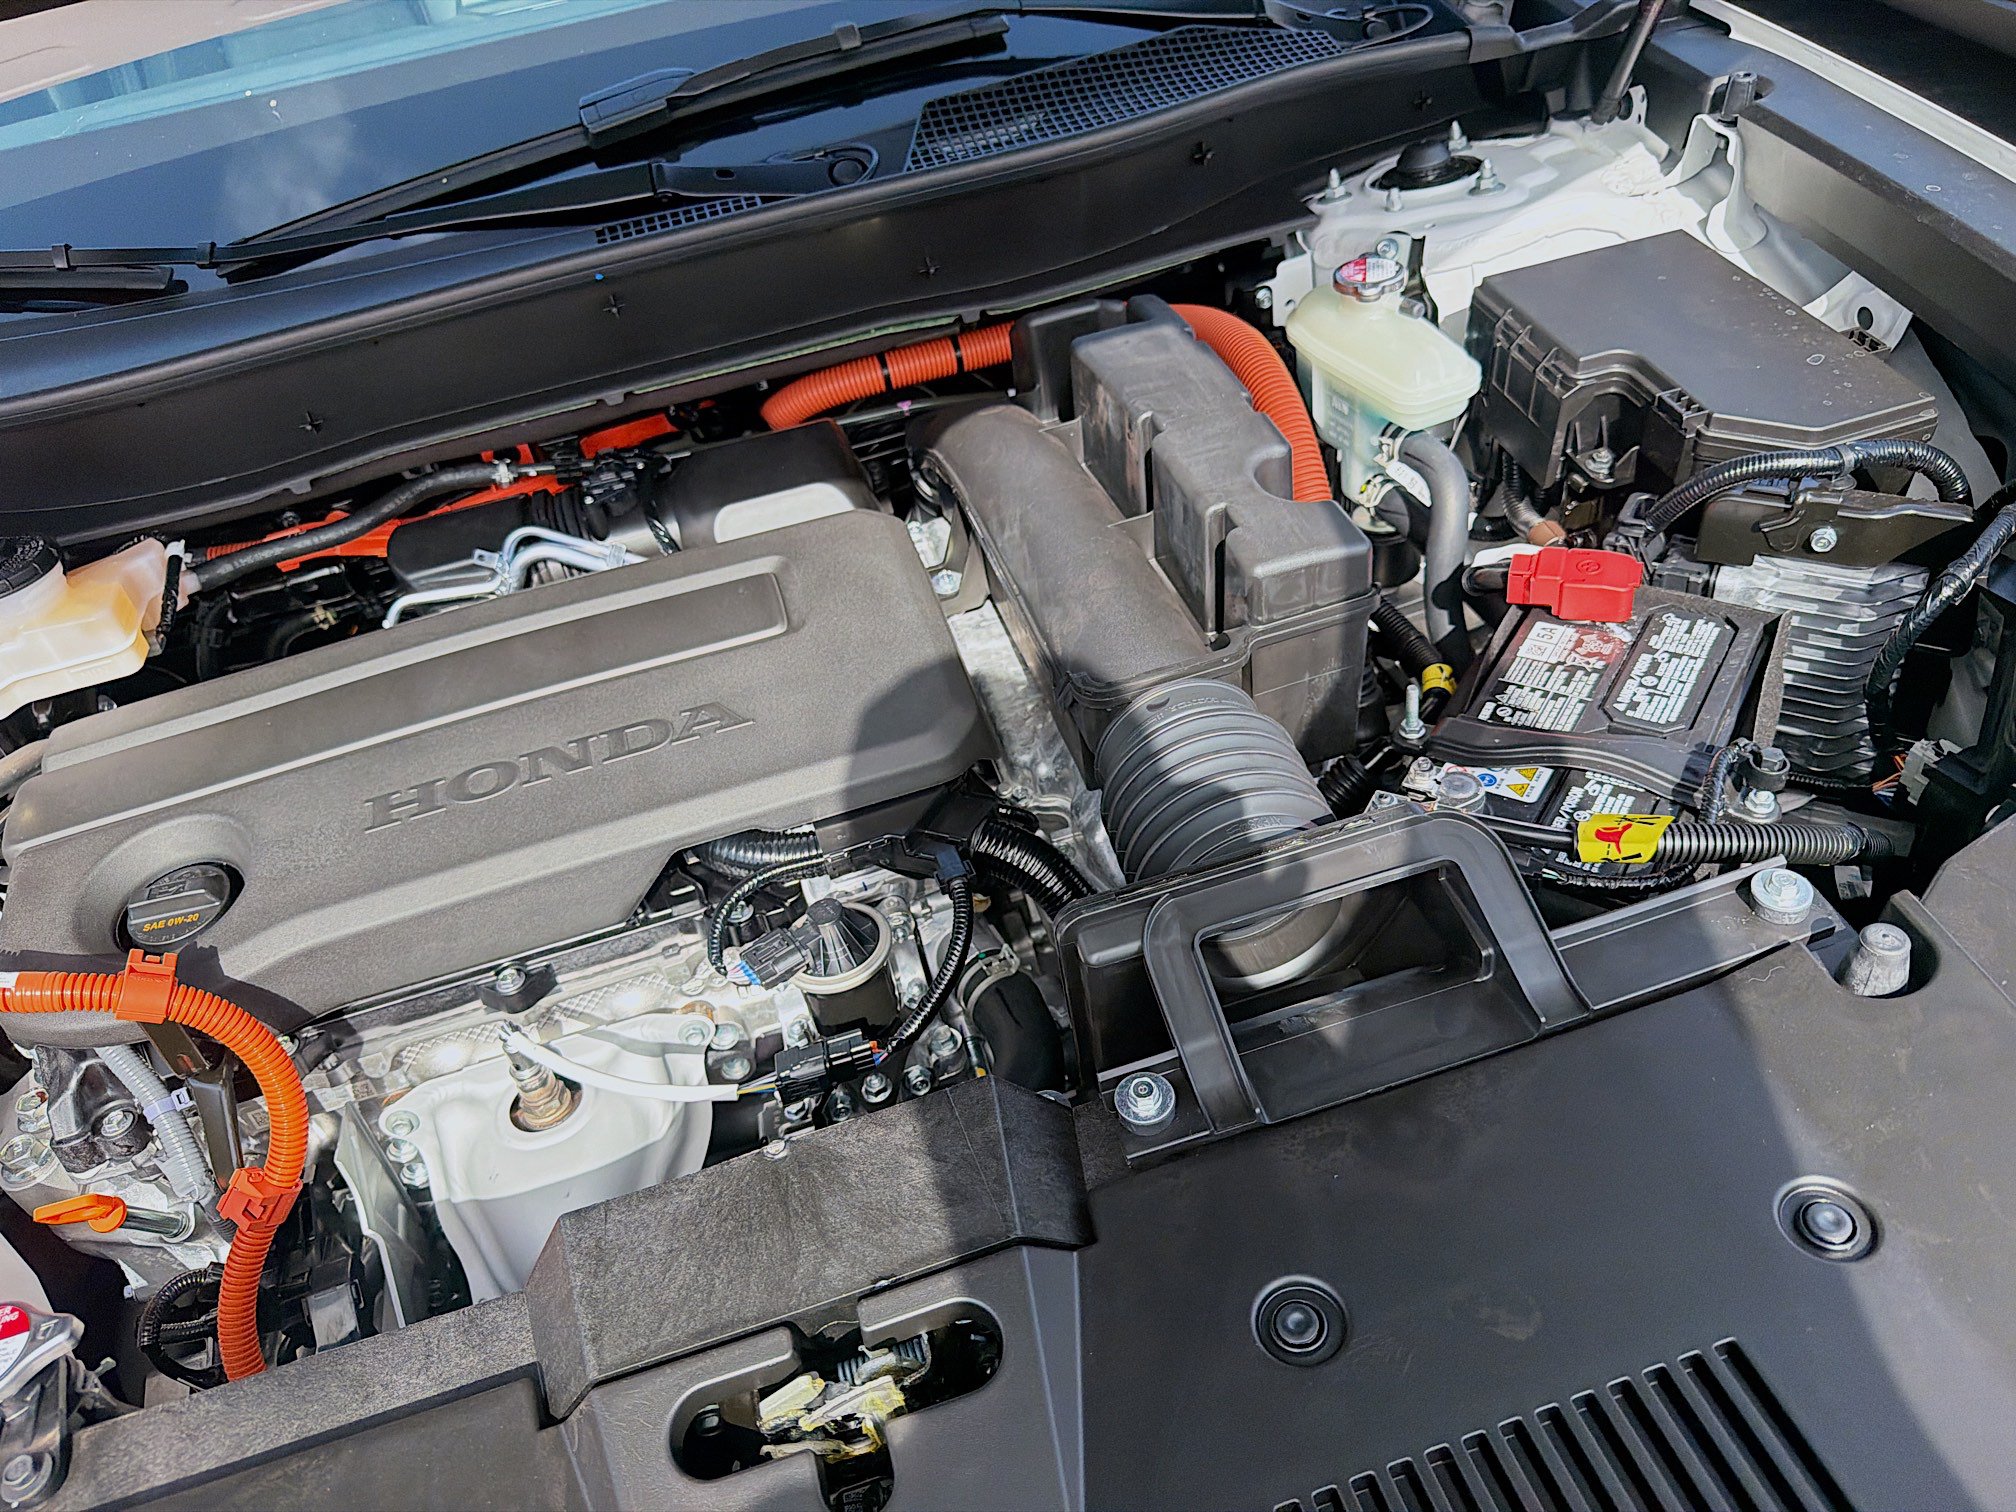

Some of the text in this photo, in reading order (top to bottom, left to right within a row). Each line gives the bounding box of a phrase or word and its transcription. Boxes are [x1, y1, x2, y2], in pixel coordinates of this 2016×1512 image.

[365, 702, 756, 833] HONDA
[142, 912, 200, 932] SAE 0W-20
